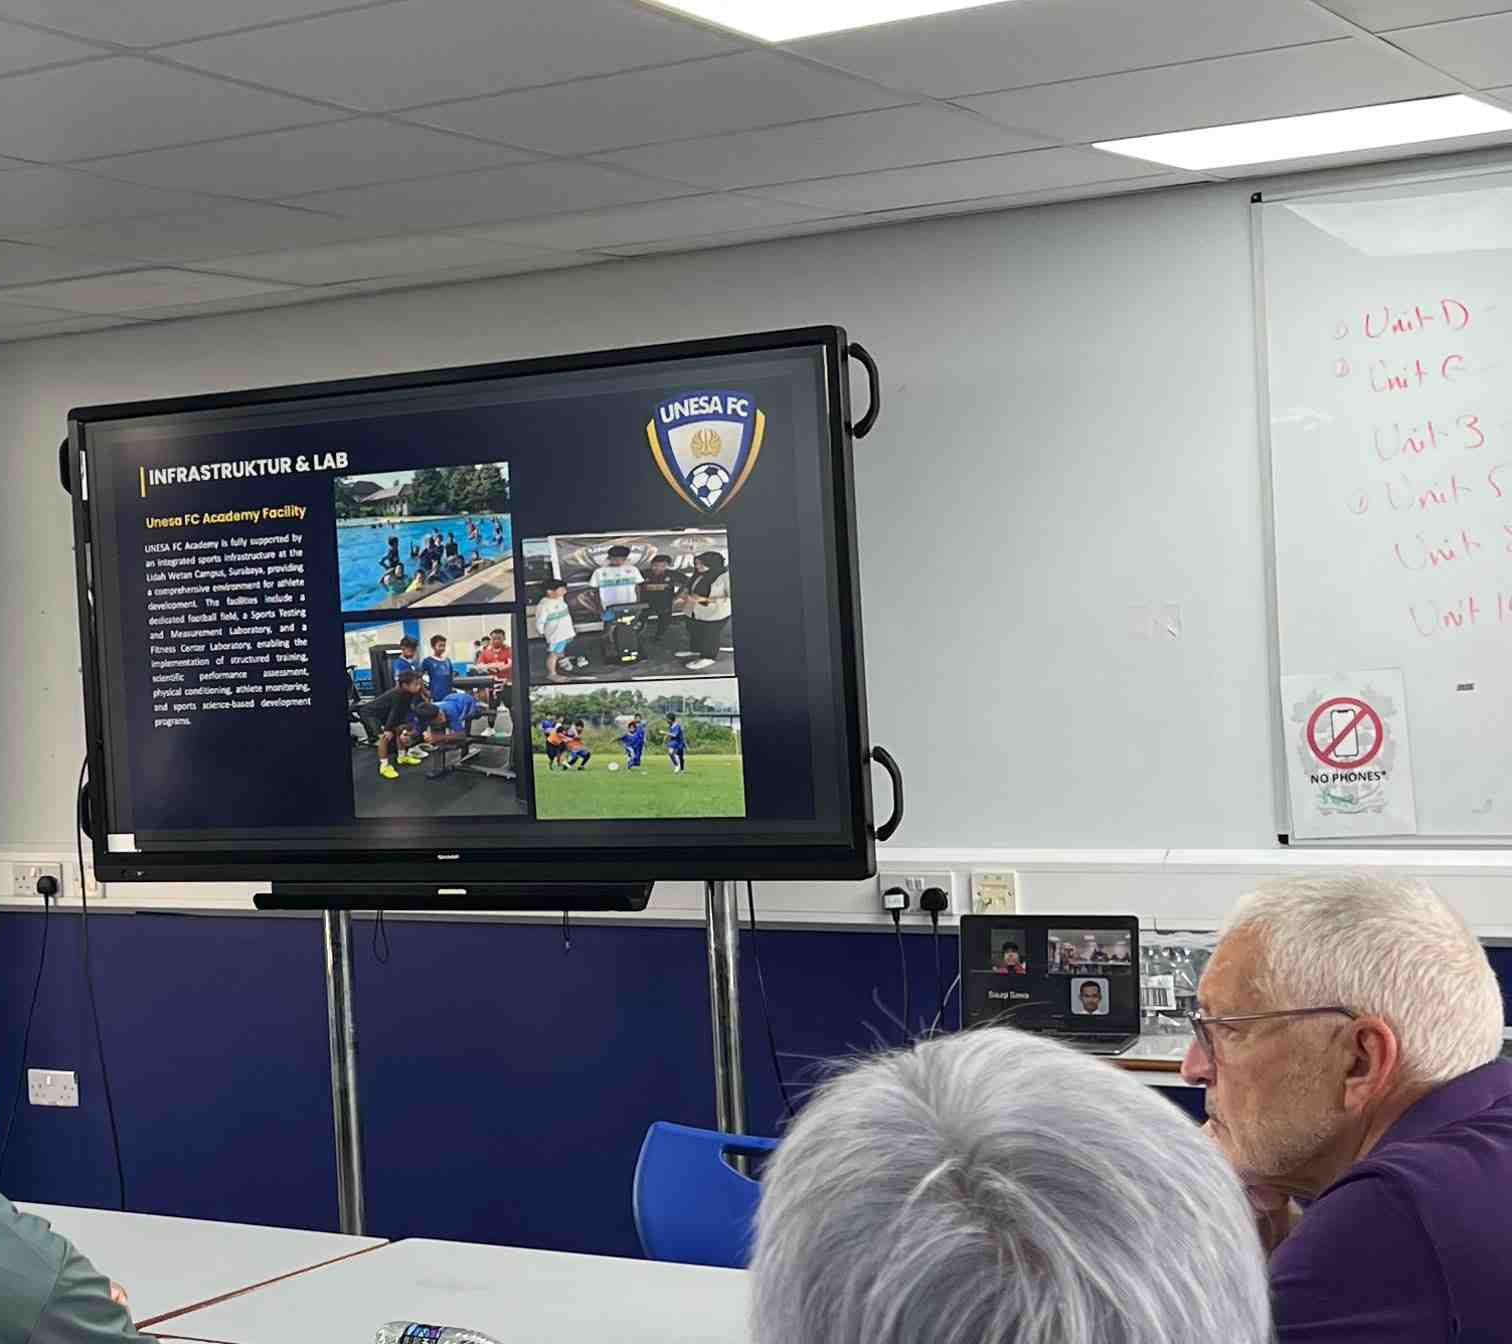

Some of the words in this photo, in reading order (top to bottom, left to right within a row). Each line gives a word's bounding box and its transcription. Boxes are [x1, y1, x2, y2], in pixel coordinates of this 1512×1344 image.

[660, 395, 723, 424] UNESA
[727, 397, 749, 417] FC
[148, 456, 292, 486] INFRASTRUKTUR
[295, 454, 311, 472] &
[313, 451, 349, 471] LAB
[145, 515, 183, 529] Unesa
[184, 513, 201, 526] FC
[202, 508, 261, 525] Academy
[262, 504, 307, 521] Facility
[144, 542, 171, 553] UNESA
[172, 541, 183, 552] FC
[184, 538, 219, 551] Academy
[230, 536, 248, 548] fully
[249, 533, 290, 546] supported
[291, 532, 303, 544] by
[157, 556, 196, 568] integrated
[197, 554, 222, 566] sports
[223, 550, 276, 563] infrastructure
[289, 547, 303, 558] the
[153, 583, 210, 597] comprehensive
[211, 580, 261, 593] environment
[205, 597, 220, 608] The
[264, 592, 293, 604] include
[148, 613, 186, 626] dedicated
[187, 611, 217, 624] football
[250, 609, 276, 621] Sports
[149, 629, 164, 640] and
[170, 627, 223, 640] Measurement
[279, 622, 295, 633] and
[150, 644, 177, 655] Fitness
[256, 637, 291, 650] enabling
[293, 637, 308, 647] the
[151, 657, 210, 670] implementation
[230, 653, 270, 665] structured
[152, 670, 185, 683] scientific
[199, 669, 248, 682] performance
[153, 687, 182, 699] physical
[259, 697, 312, 710] development
[1310, 772, 1329, 785] NO
